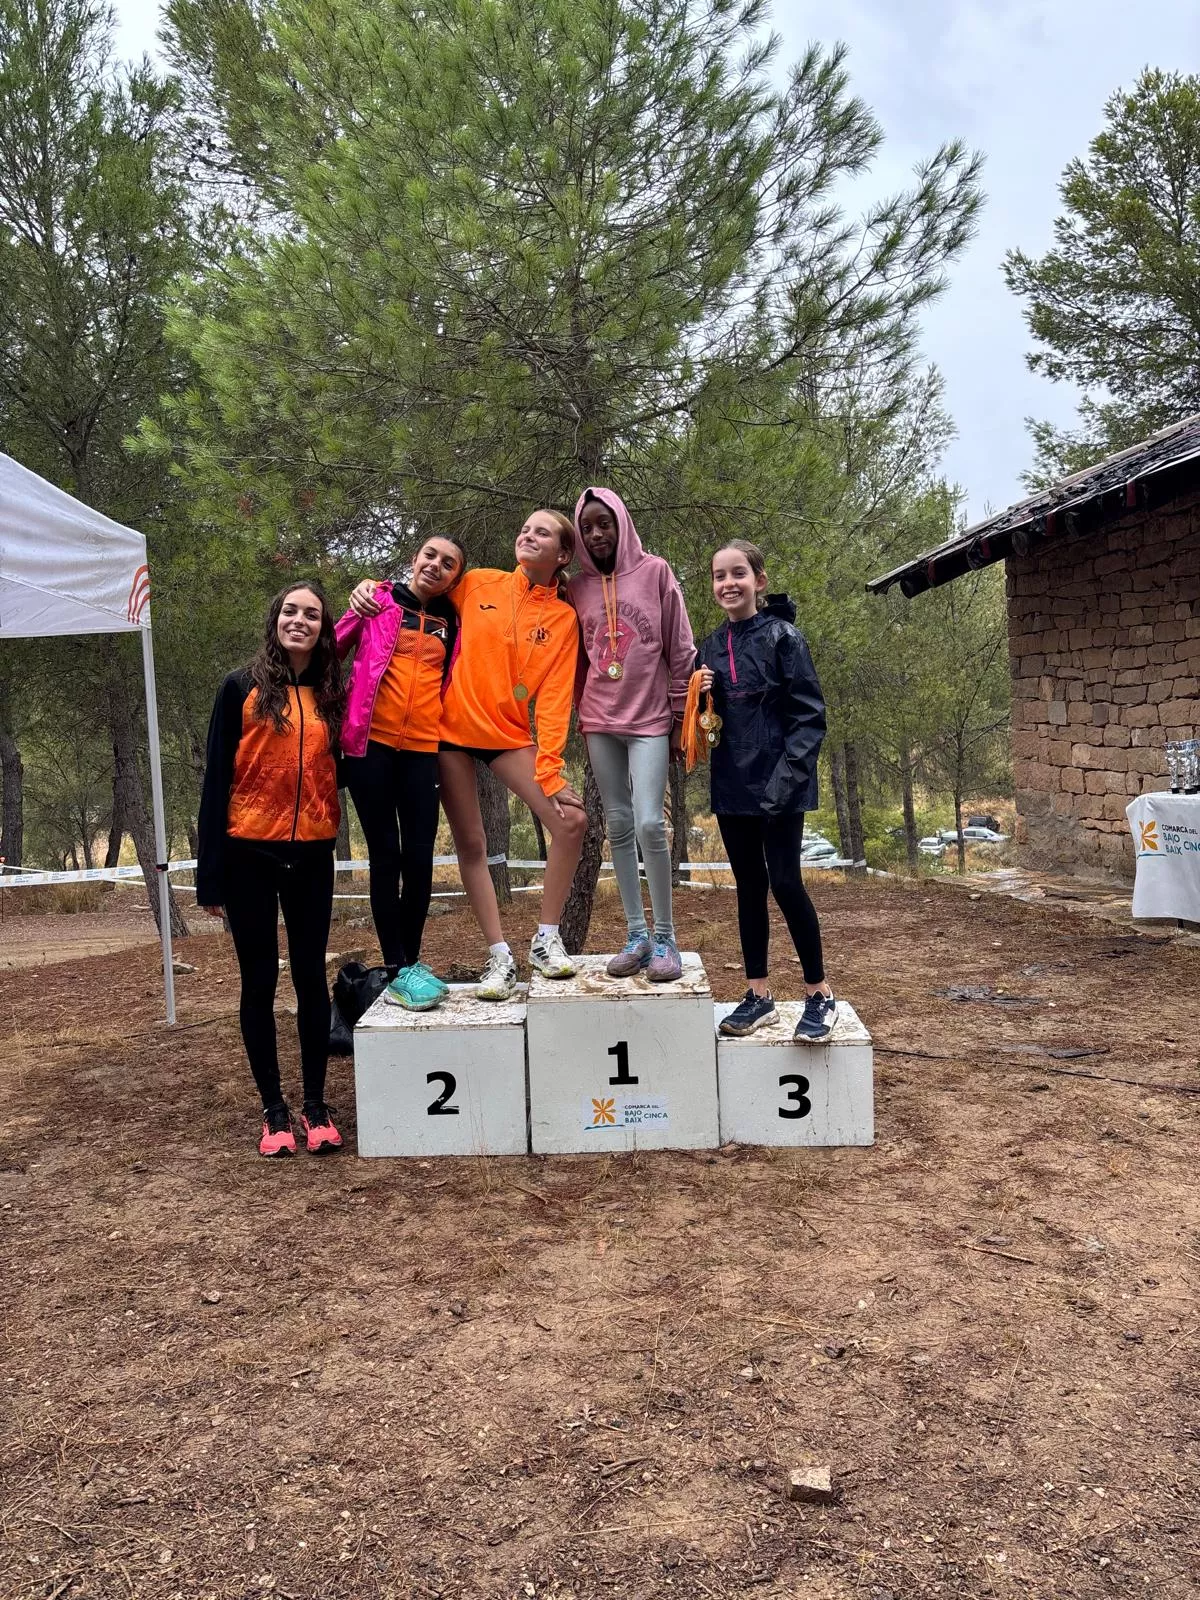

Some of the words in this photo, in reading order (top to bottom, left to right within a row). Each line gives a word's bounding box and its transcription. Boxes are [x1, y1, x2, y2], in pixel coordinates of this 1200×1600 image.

[1161, 824, 1188, 833] COMARCA
[1163, 833, 1181, 844] BAJO
[1166, 844, 1183, 855] BAIX
[608, 1041, 639, 1086] 1
[427, 1071, 460, 1116] 2
[779, 1075, 812, 1120] 3
